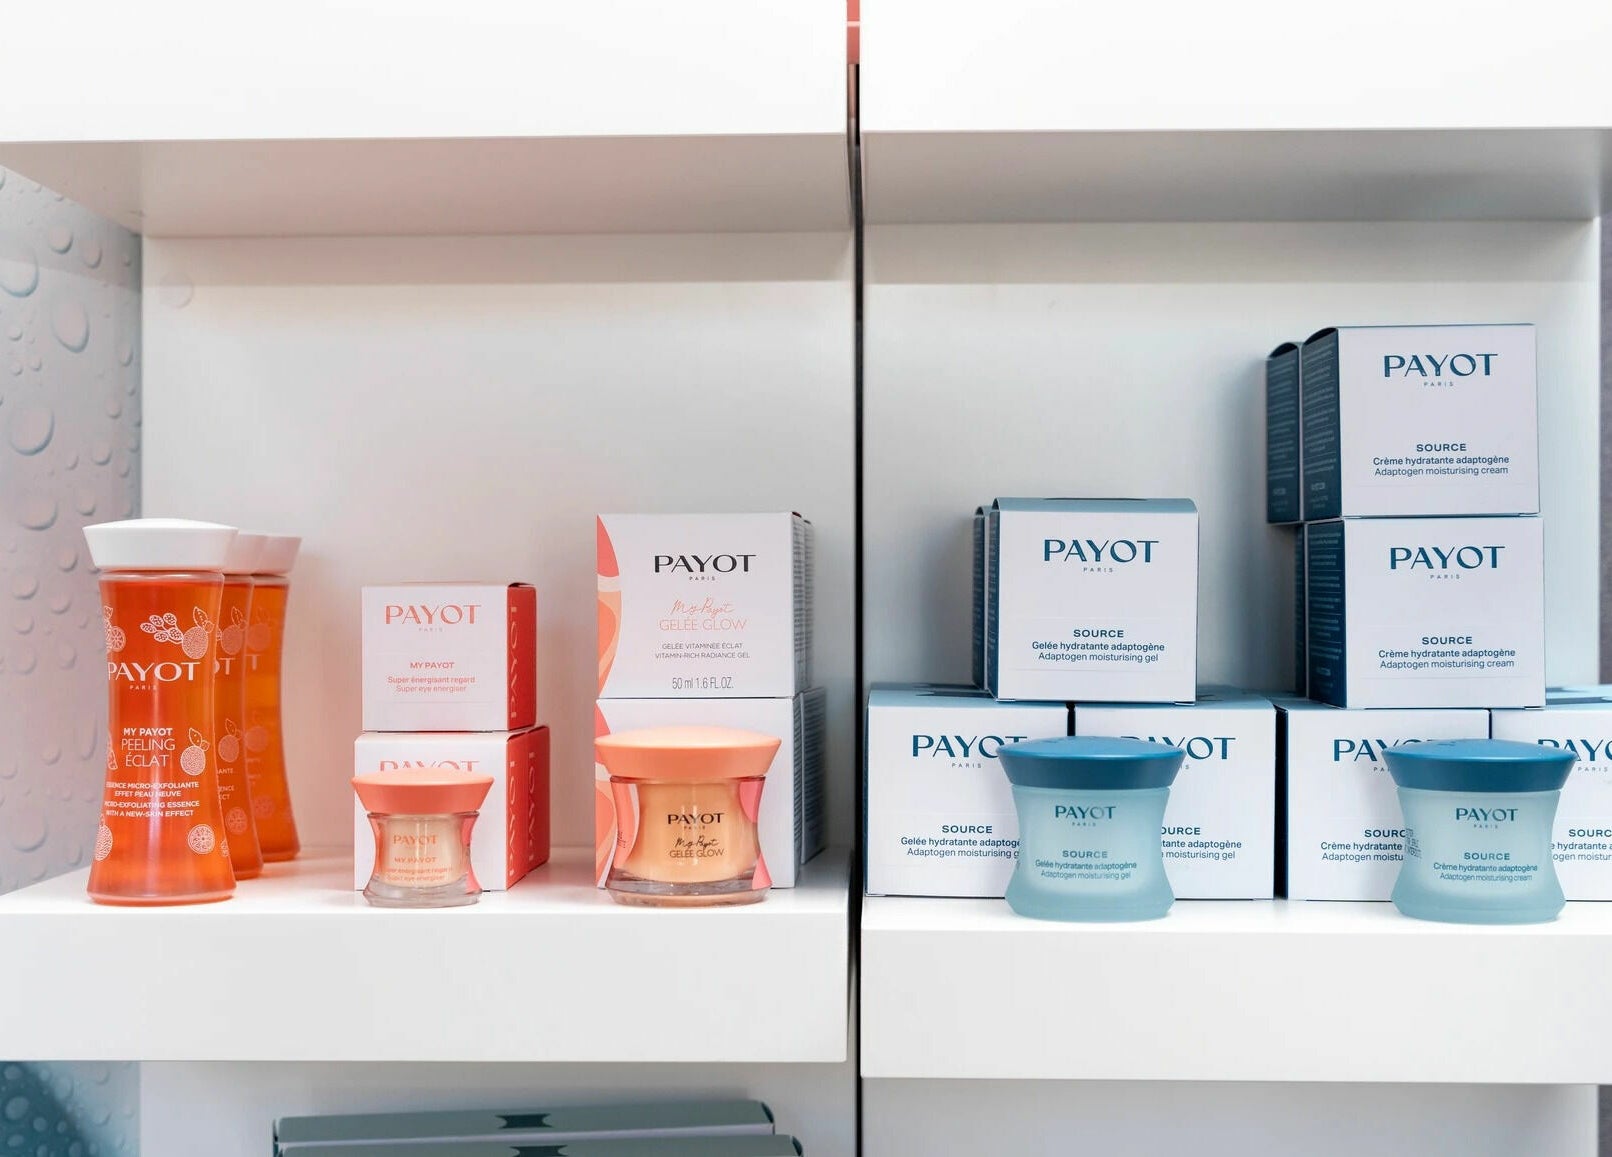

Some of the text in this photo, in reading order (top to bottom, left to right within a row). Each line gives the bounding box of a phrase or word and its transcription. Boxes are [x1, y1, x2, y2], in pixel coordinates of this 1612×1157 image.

[1384, 354, 1498, 377] PAYOT
[1416, 443, 1467, 452] SOURCE
[1373, 455, 1509, 466] Crème hydratante adaptogène
[1375, 467, 1423, 477] Adaptogen
[1426, 466, 1479, 476] moisturising
[1044, 539, 1159, 563] PAYOT
[1390, 546, 1505, 569] PAYOT
[655, 554, 756, 573] PAYOT
[385, 604, 482, 625] PAYOT
[659, 616, 747, 631] GELÉE GLOW
[1073, 629, 1124, 638] SOURCE
[1422, 636, 1473, 645] SOURCE
[1032, 641, 1165, 653] Gelée hydratante adaptogène
[1038, 652, 1159, 664] Adaptogen moisturising gel
[1378, 649, 1516, 659] Crème hydratante adaptogène
[1380, 659, 1514, 670] Adaptogen moisturising cream
[107, 662, 201, 682] PAYOT
[388, 676, 476, 685] Super énergisant regard
[672, 678, 682, 689] 50
[684, 678, 693, 689] ml
[696, 678, 709, 689] 1.6
[396, 686, 417, 694] Super
[433, 686, 467, 694] energiser
[121, 738, 176, 751] PEELING
[912, 735, 1027, 758] PAYO
[125, 752, 169, 767] ÉCLAT
[1055, 805, 1117, 819] PAYOT
[1456, 808, 1518, 821] PAYOT
[667, 813, 724, 824] PAYOT
[942, 825, 993, 834] SOURCE
[1364, 829, 1406, 838] SOURC
[1568, 829, 1612, 837] SOURC
[393, 835, 438, 845] PAYOT
[901, 837, 927, 845] Gelée
[929, 837, 978, 848] hydratante
[1188, 840, 1242, 850] adaptogène
[1321, 841, 1403, 852] Crème hydratante
[1557, 842, 1607, 852] hydratante
[696, 849, 725, 857] GLOW
[907, 848, 956, 858] Adaptogen
[958, 848, 1012, 859] moisturising
[1062, 850, 1108, 859] SOURCE
[1166, 850, 1220, 861] moisturising
[1222, 850, 1236, 861] gel
[1322, 852, 1404, 862] Adaptogen moistu
[1464, 852, 1510, 860] SOURCE
[1578, 853, 1612, 861] moistur
[1035, 859, 1138, 871] Gelée hydratante adaptogène
[1433, 862, 1538, 873] Crème hydratante adaptogène
[1041, 870, 1131, 881] Adaptogen moisturising gel
[1440, 872, 1475, 882] Adaptogen
[1476, 873, 1513, 883] moisturising
